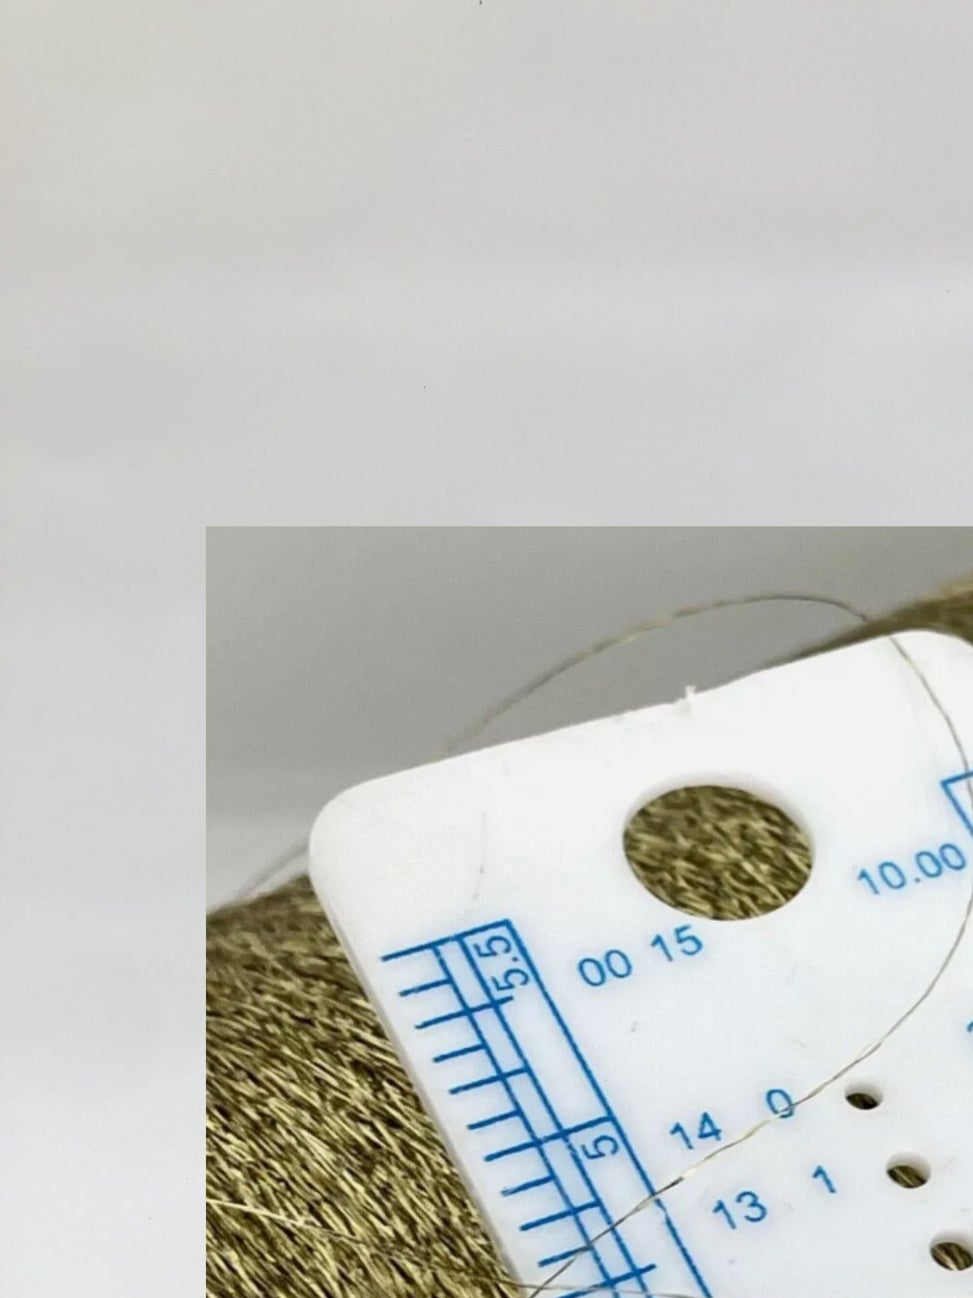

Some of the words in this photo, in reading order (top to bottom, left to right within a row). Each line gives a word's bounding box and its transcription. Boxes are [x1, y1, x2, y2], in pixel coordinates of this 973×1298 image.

[858, 842, 968, 894] 10.00
[474, 932, 532, 992] 5.5
[577, 949, 634, 987] 00
[651, 924, 704, 959] 15
[580, 1132, 620, 1161] 5
[670, 1112, 723, 1149] 14
[764, 1088, 794, 1119] 0
[713, 1190, 768, 1228] 13
[812, 1165, 837, 1195] 1
